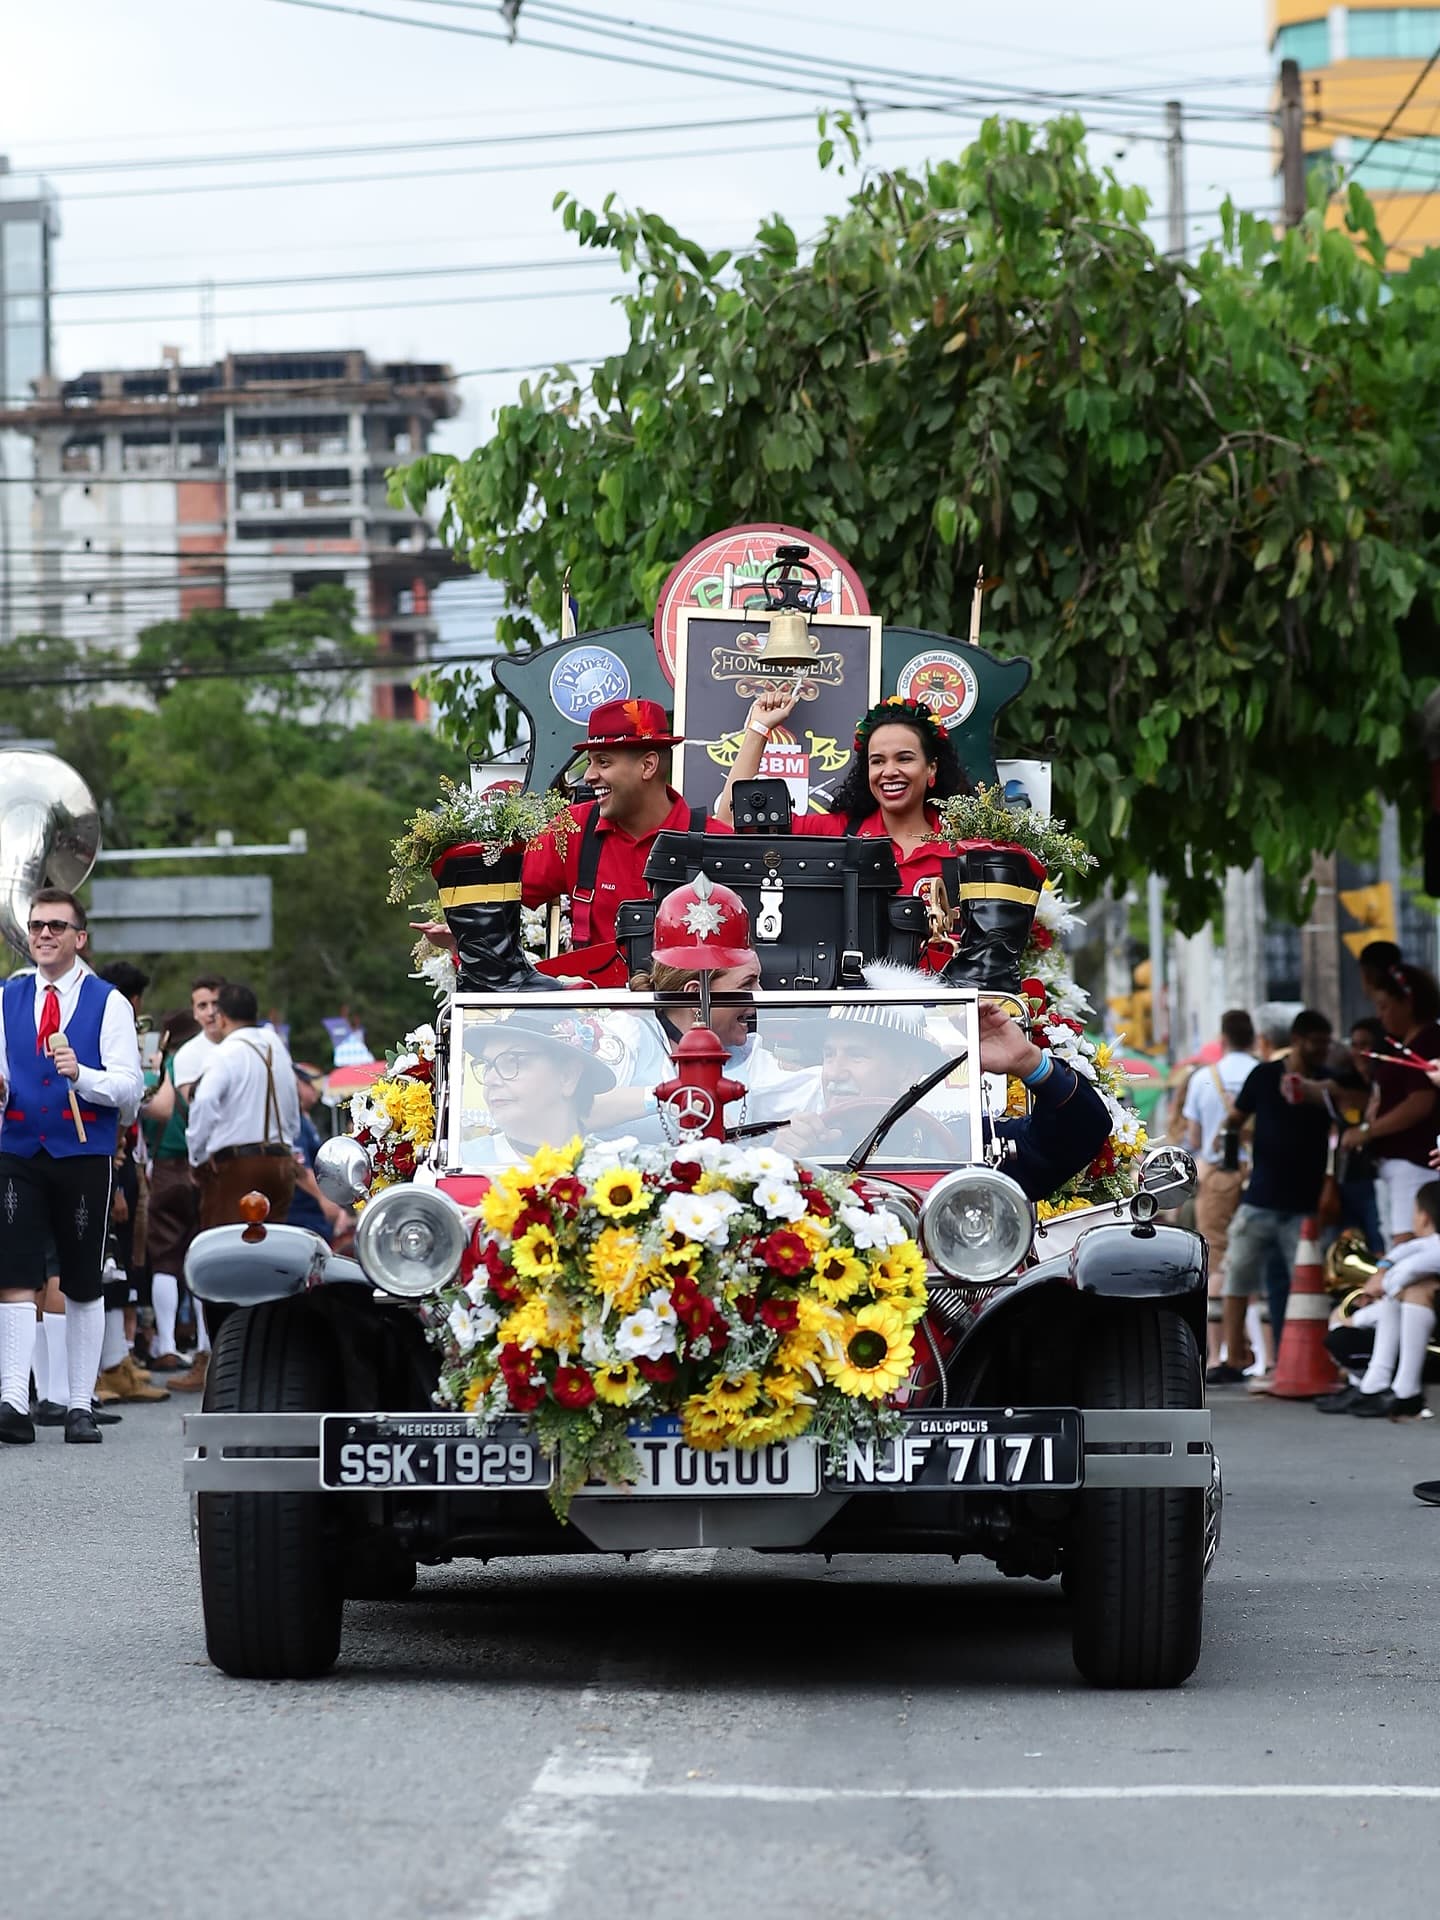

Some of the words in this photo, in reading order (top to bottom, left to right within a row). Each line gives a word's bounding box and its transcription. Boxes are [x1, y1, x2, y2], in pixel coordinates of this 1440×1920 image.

[902, 668, 915, 689] CORPO
[913, 659, 924, 669] DE
[923, 655, 961, 668] BOMBEIROS
[961, 667, 974, 692] MILITAR
[846, 1437, 931, 1483] NJF
[948, 1437, 1055, 1482] 7171
